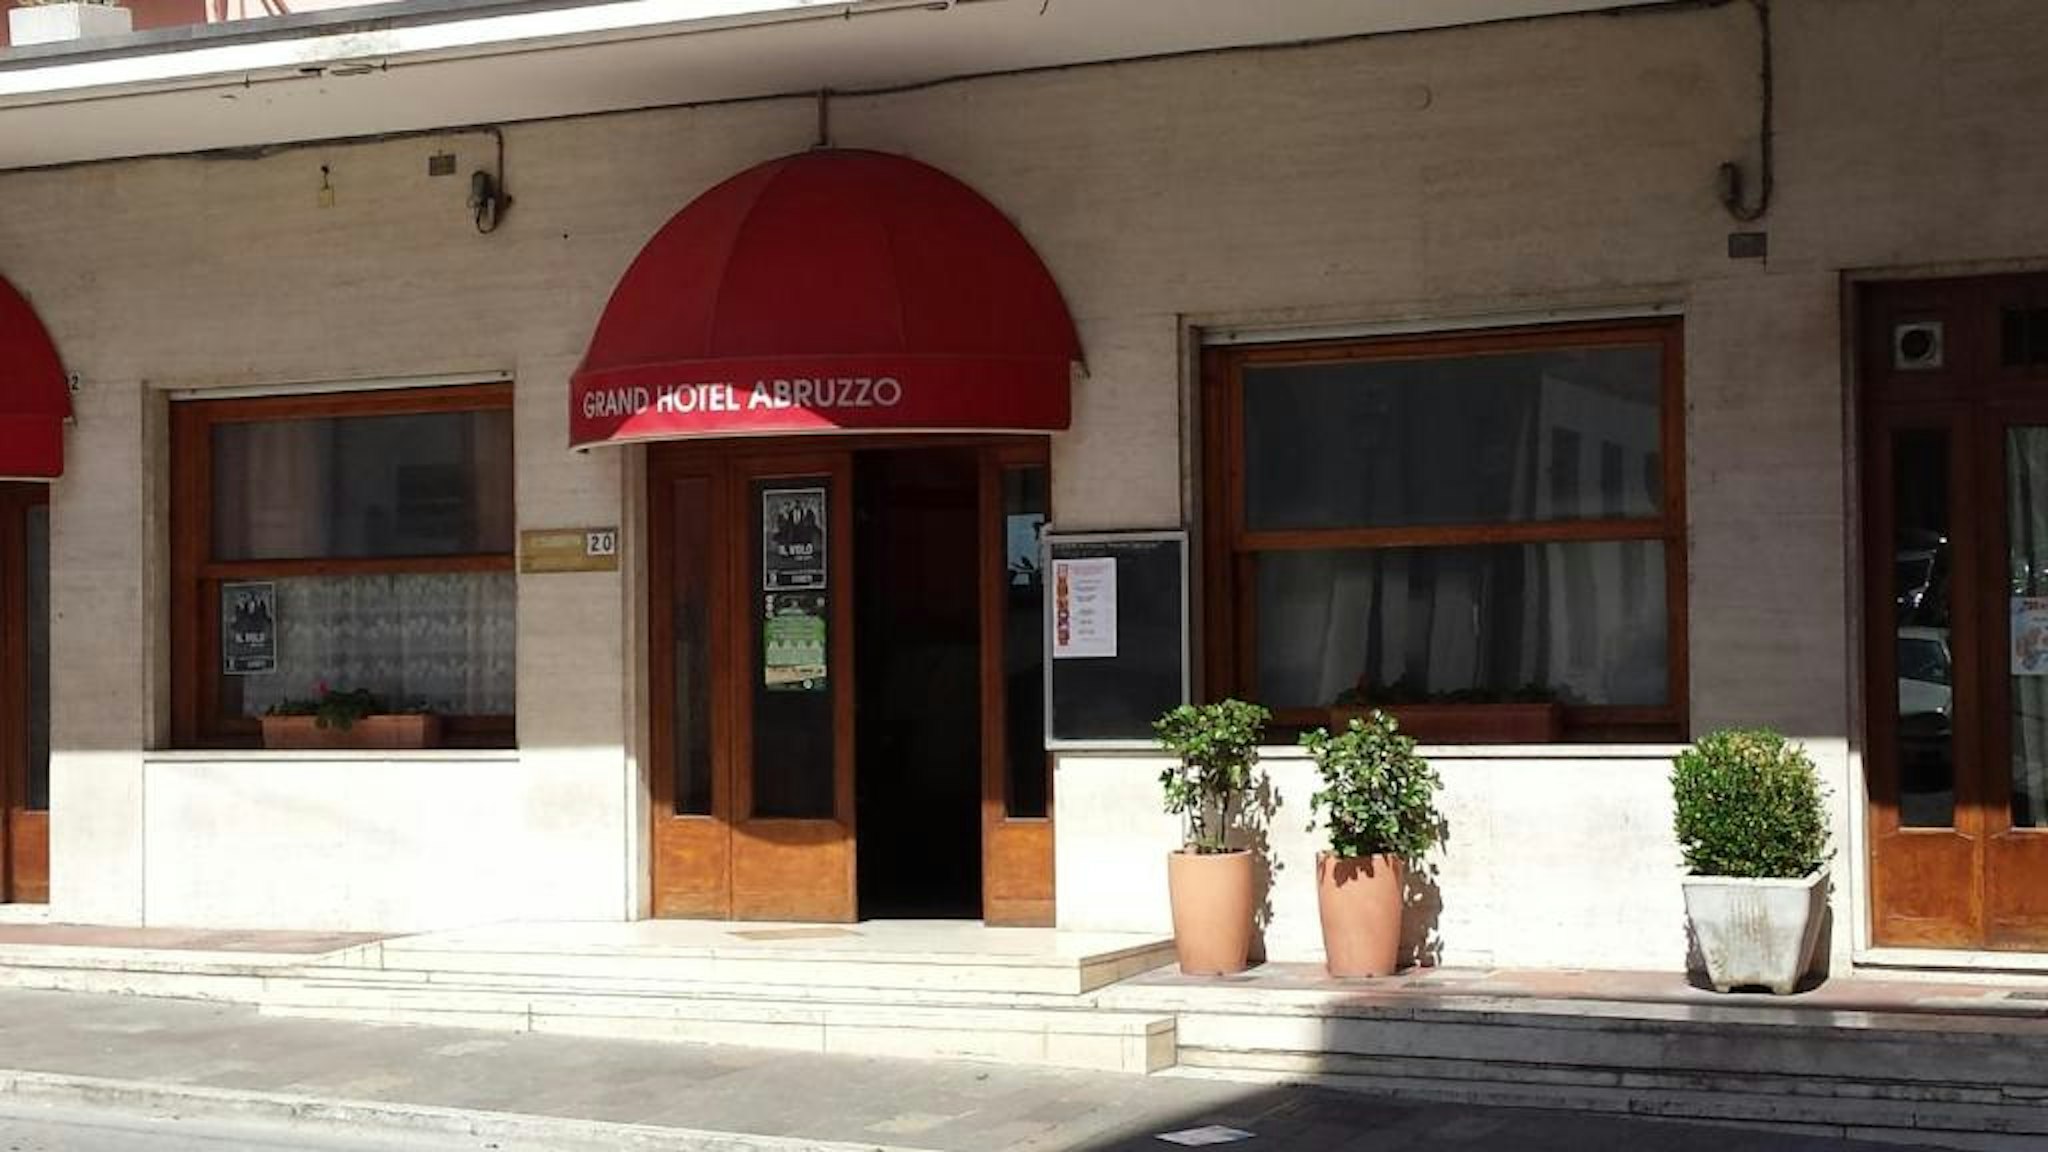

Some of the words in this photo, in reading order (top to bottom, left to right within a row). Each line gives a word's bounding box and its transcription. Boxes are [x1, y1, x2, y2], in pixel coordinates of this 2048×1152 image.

[583, 387, 649, 419] GRAND
[656, 383, 740, 414] HOTEL
[748, 377, 901, 410] ABRUZZO
[591, 535, 611, 552] 20
